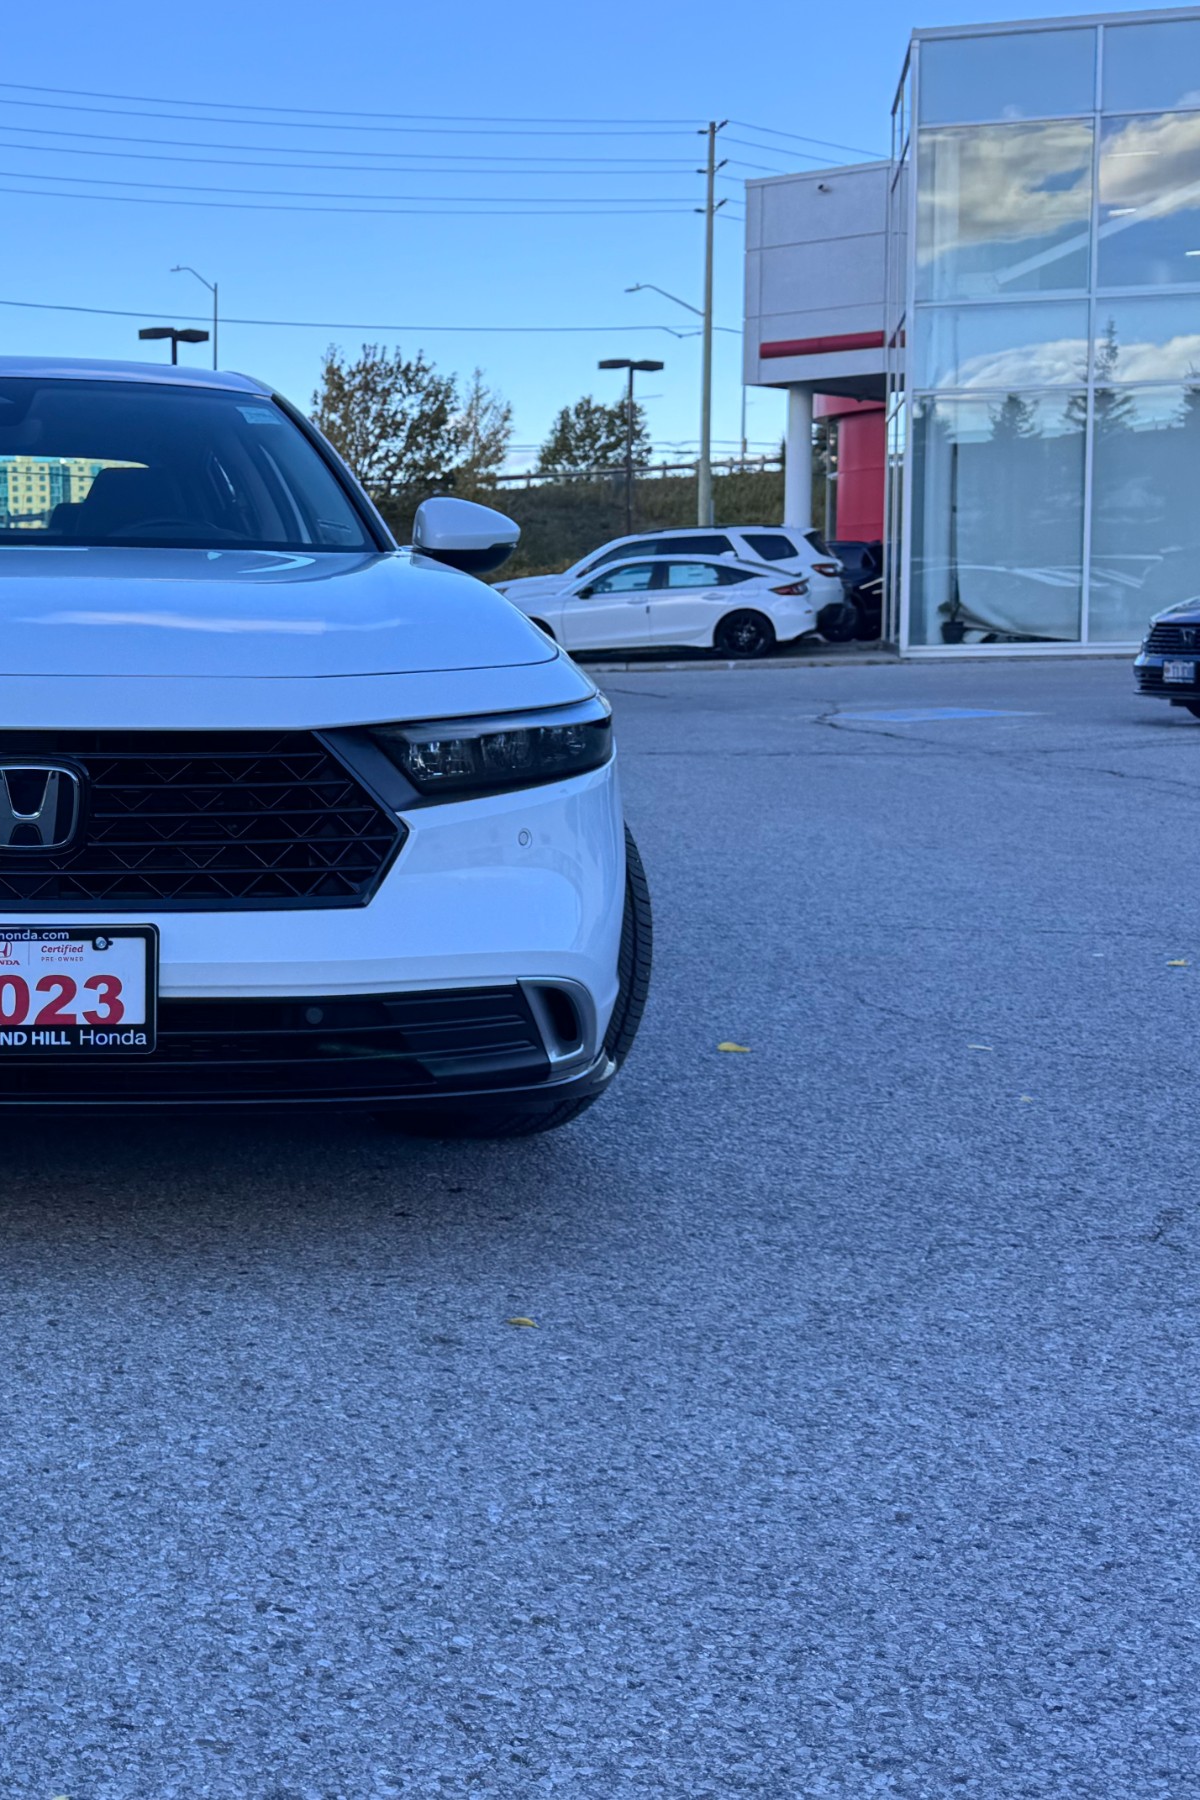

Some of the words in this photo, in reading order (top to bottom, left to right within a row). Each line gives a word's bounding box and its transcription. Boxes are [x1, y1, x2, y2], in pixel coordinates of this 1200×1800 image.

[40, 944, 84, 955] Certified
[31, 1030, 71, 1046] HILL
[79, 1029, 147, 1046] Honda
